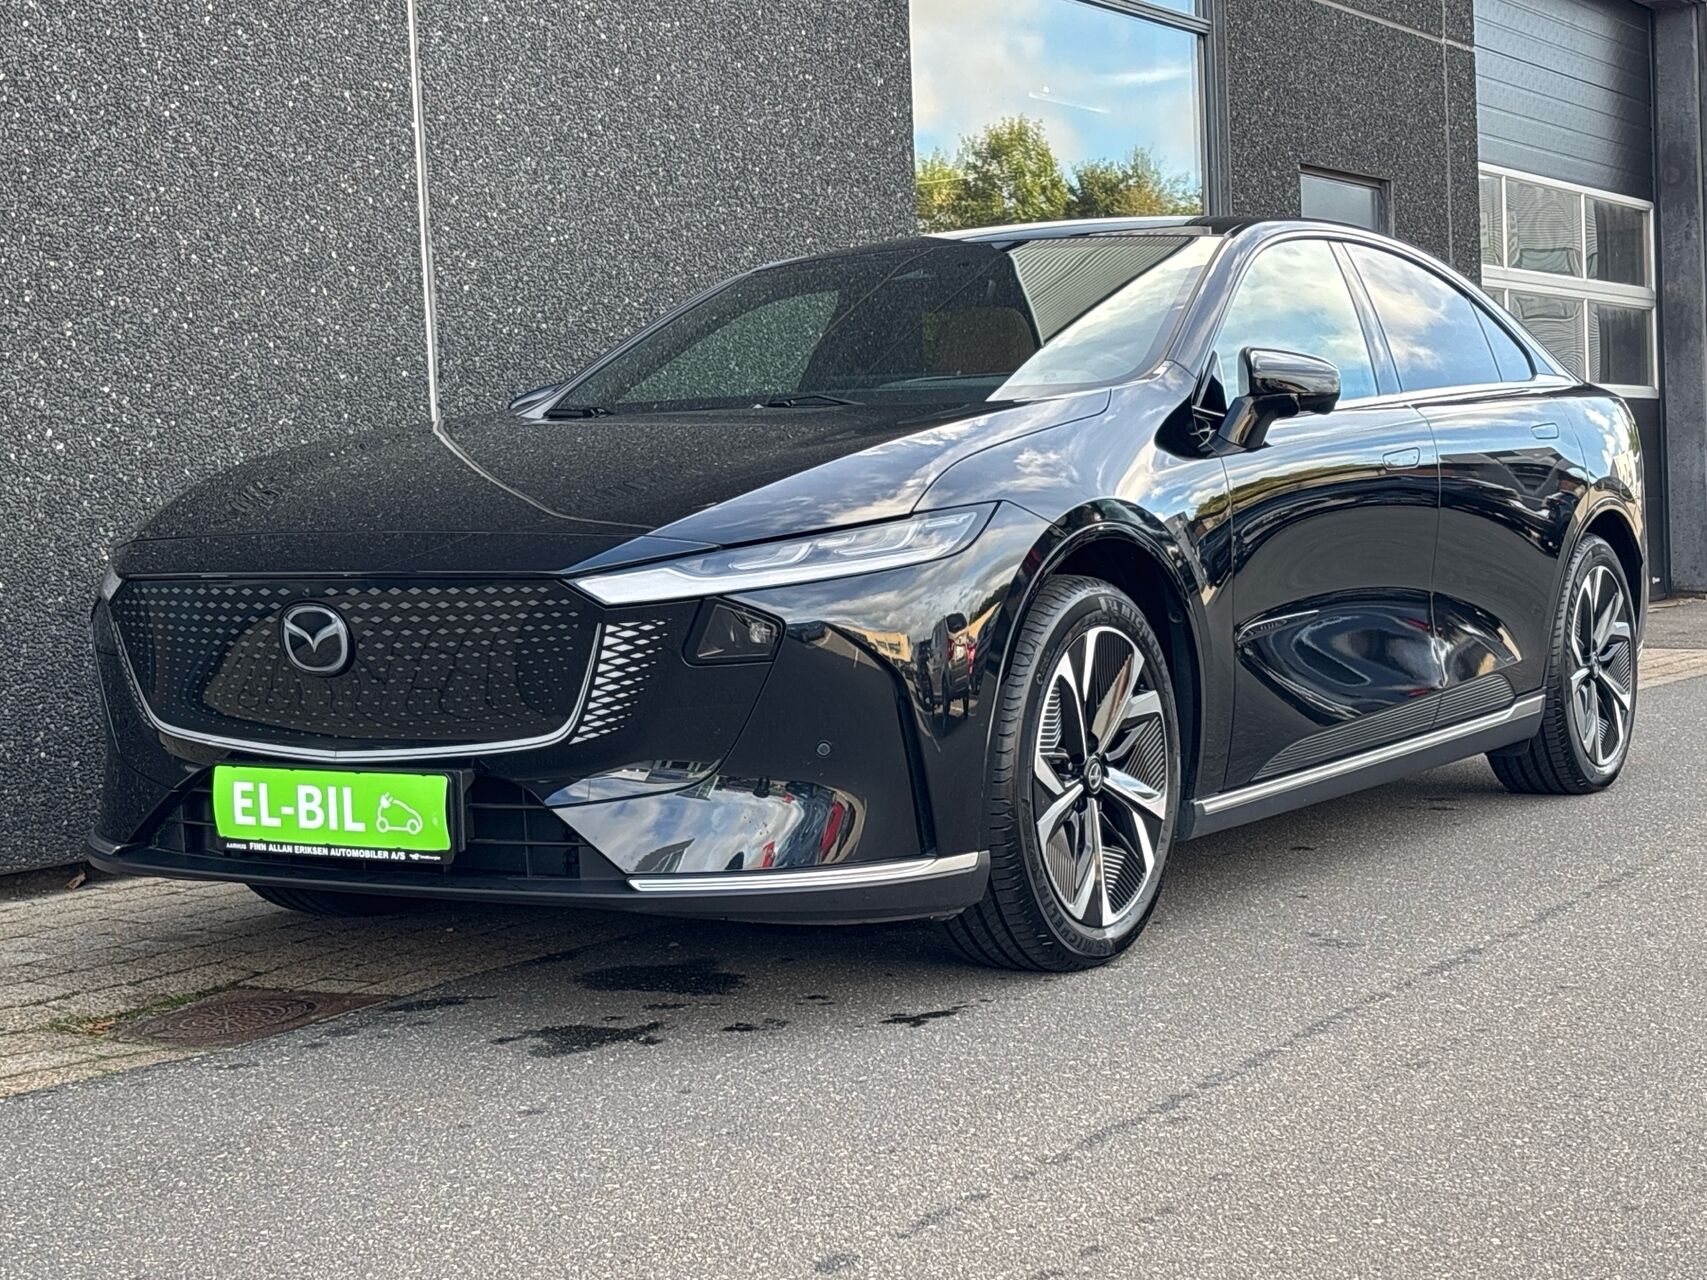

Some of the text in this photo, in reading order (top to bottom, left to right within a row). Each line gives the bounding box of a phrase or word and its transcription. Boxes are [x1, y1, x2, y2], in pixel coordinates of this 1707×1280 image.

[232, 781, 366, 832] EL-BIL
[249, 842, 267, 851] FINN
[268, 844, 293, 854] ALLAN
[294, 846, 328, 856] ERIKSEN
[330, 848, 390, 859] AUTOMOBILER
[391, 851, 406, 860] A/S
